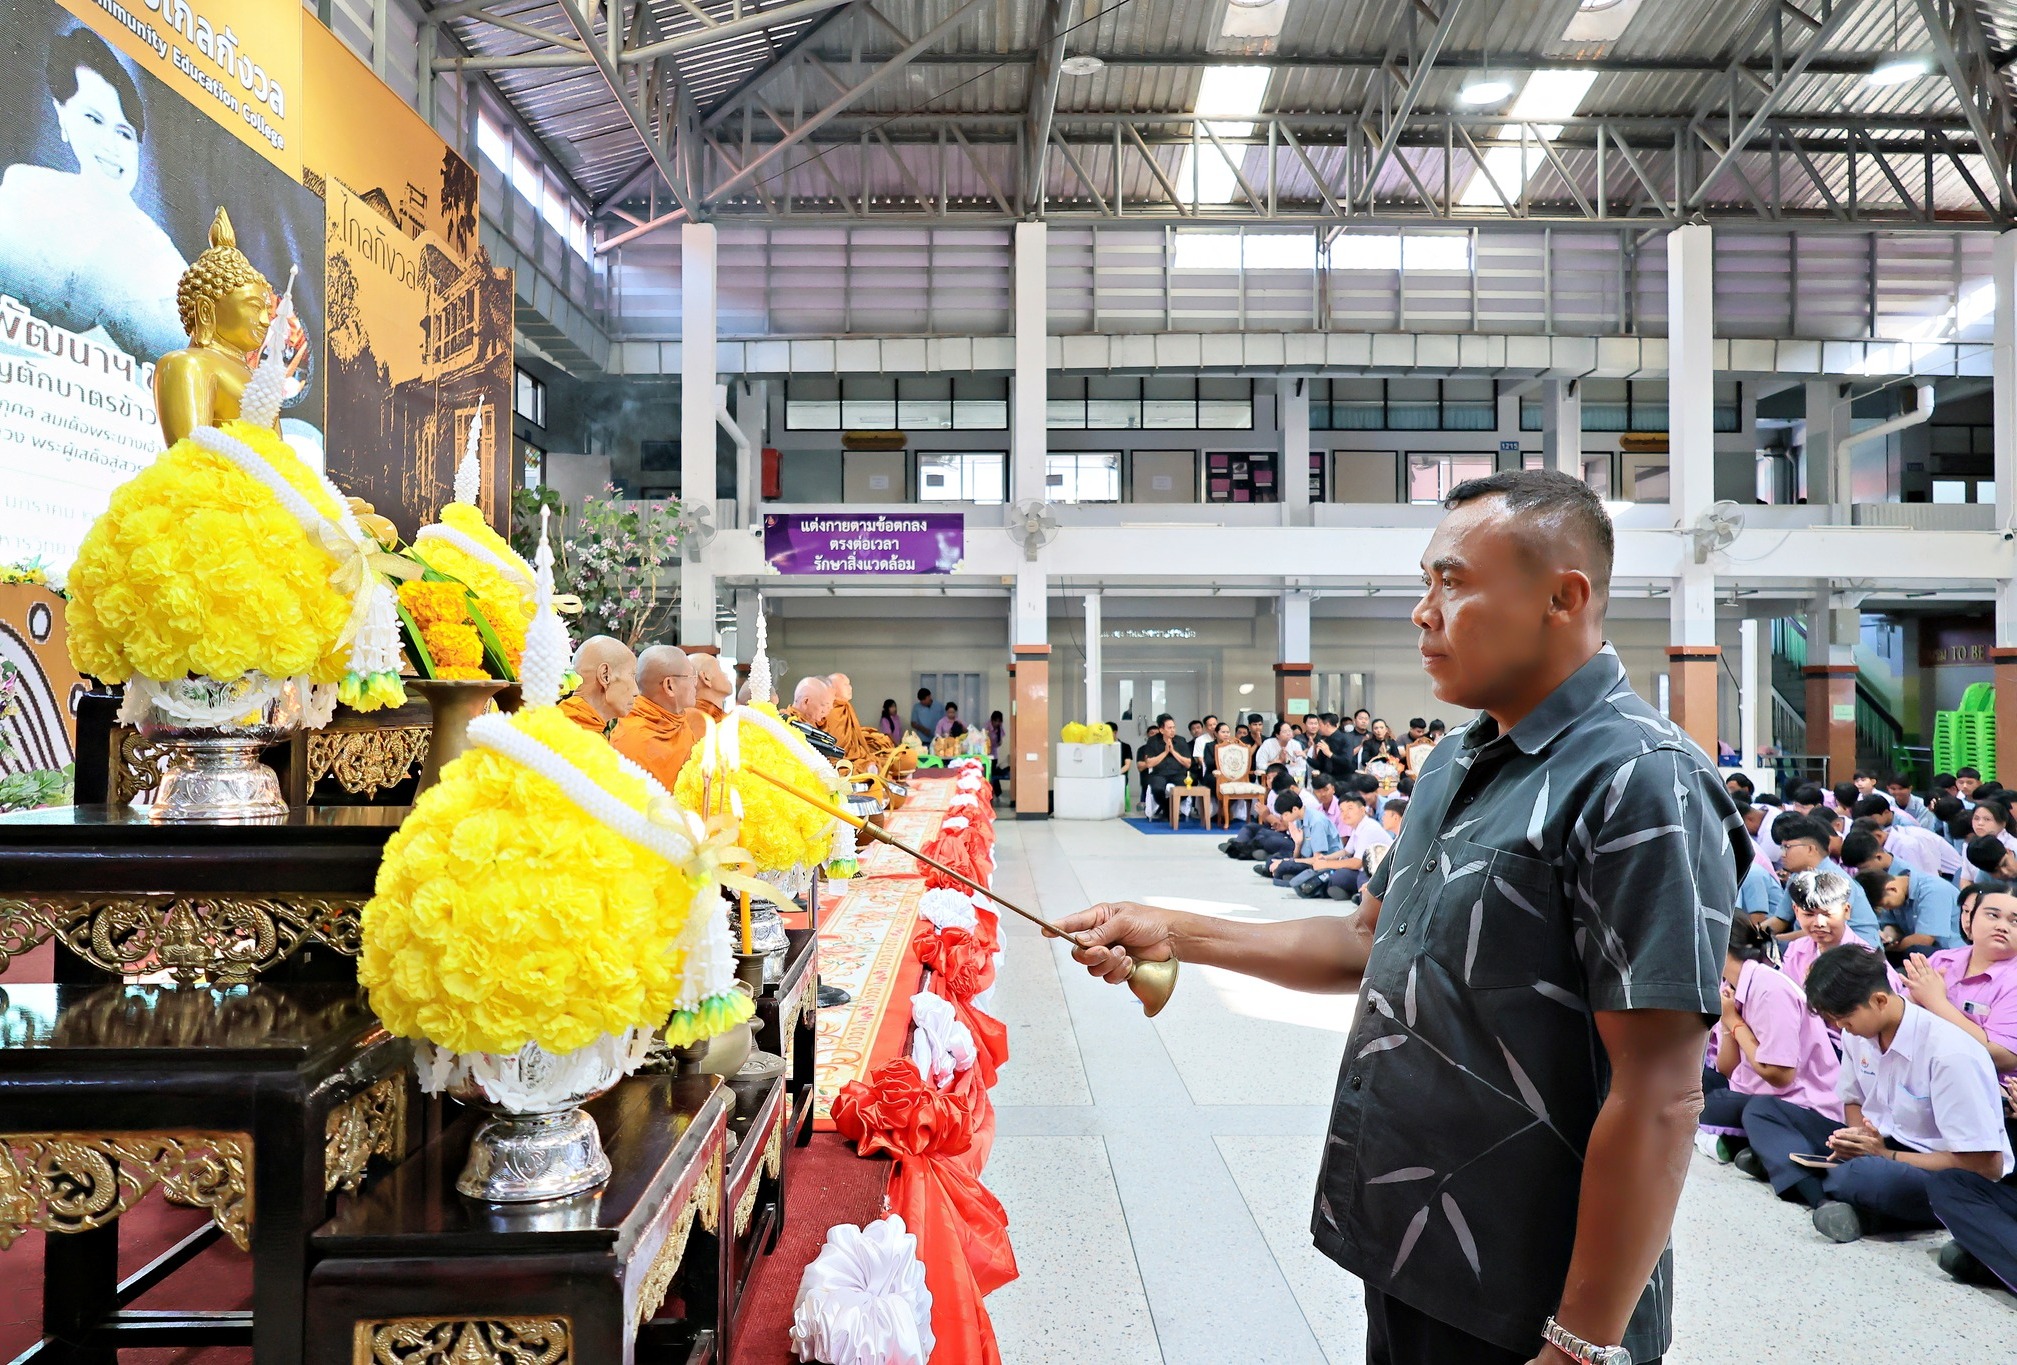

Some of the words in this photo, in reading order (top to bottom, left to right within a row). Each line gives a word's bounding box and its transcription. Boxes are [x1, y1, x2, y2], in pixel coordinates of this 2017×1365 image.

[92, 0, 168, 59] mmunity
[172, 45, 239, 114] Education
[242, 103, 285, 151] College
[341, 190, 416, 291] ไกลกังวล
[0, 427, 25, 444] วง
[801, 516, 927, 533] แต่งกายตามข้อตกลง
[829, 536, 899, 551] ตรงต่อเวลา
[814, 553, 915, 571] รักษาสิ่งแวดล้อม
[1952, 645, 1967, 660] TO
